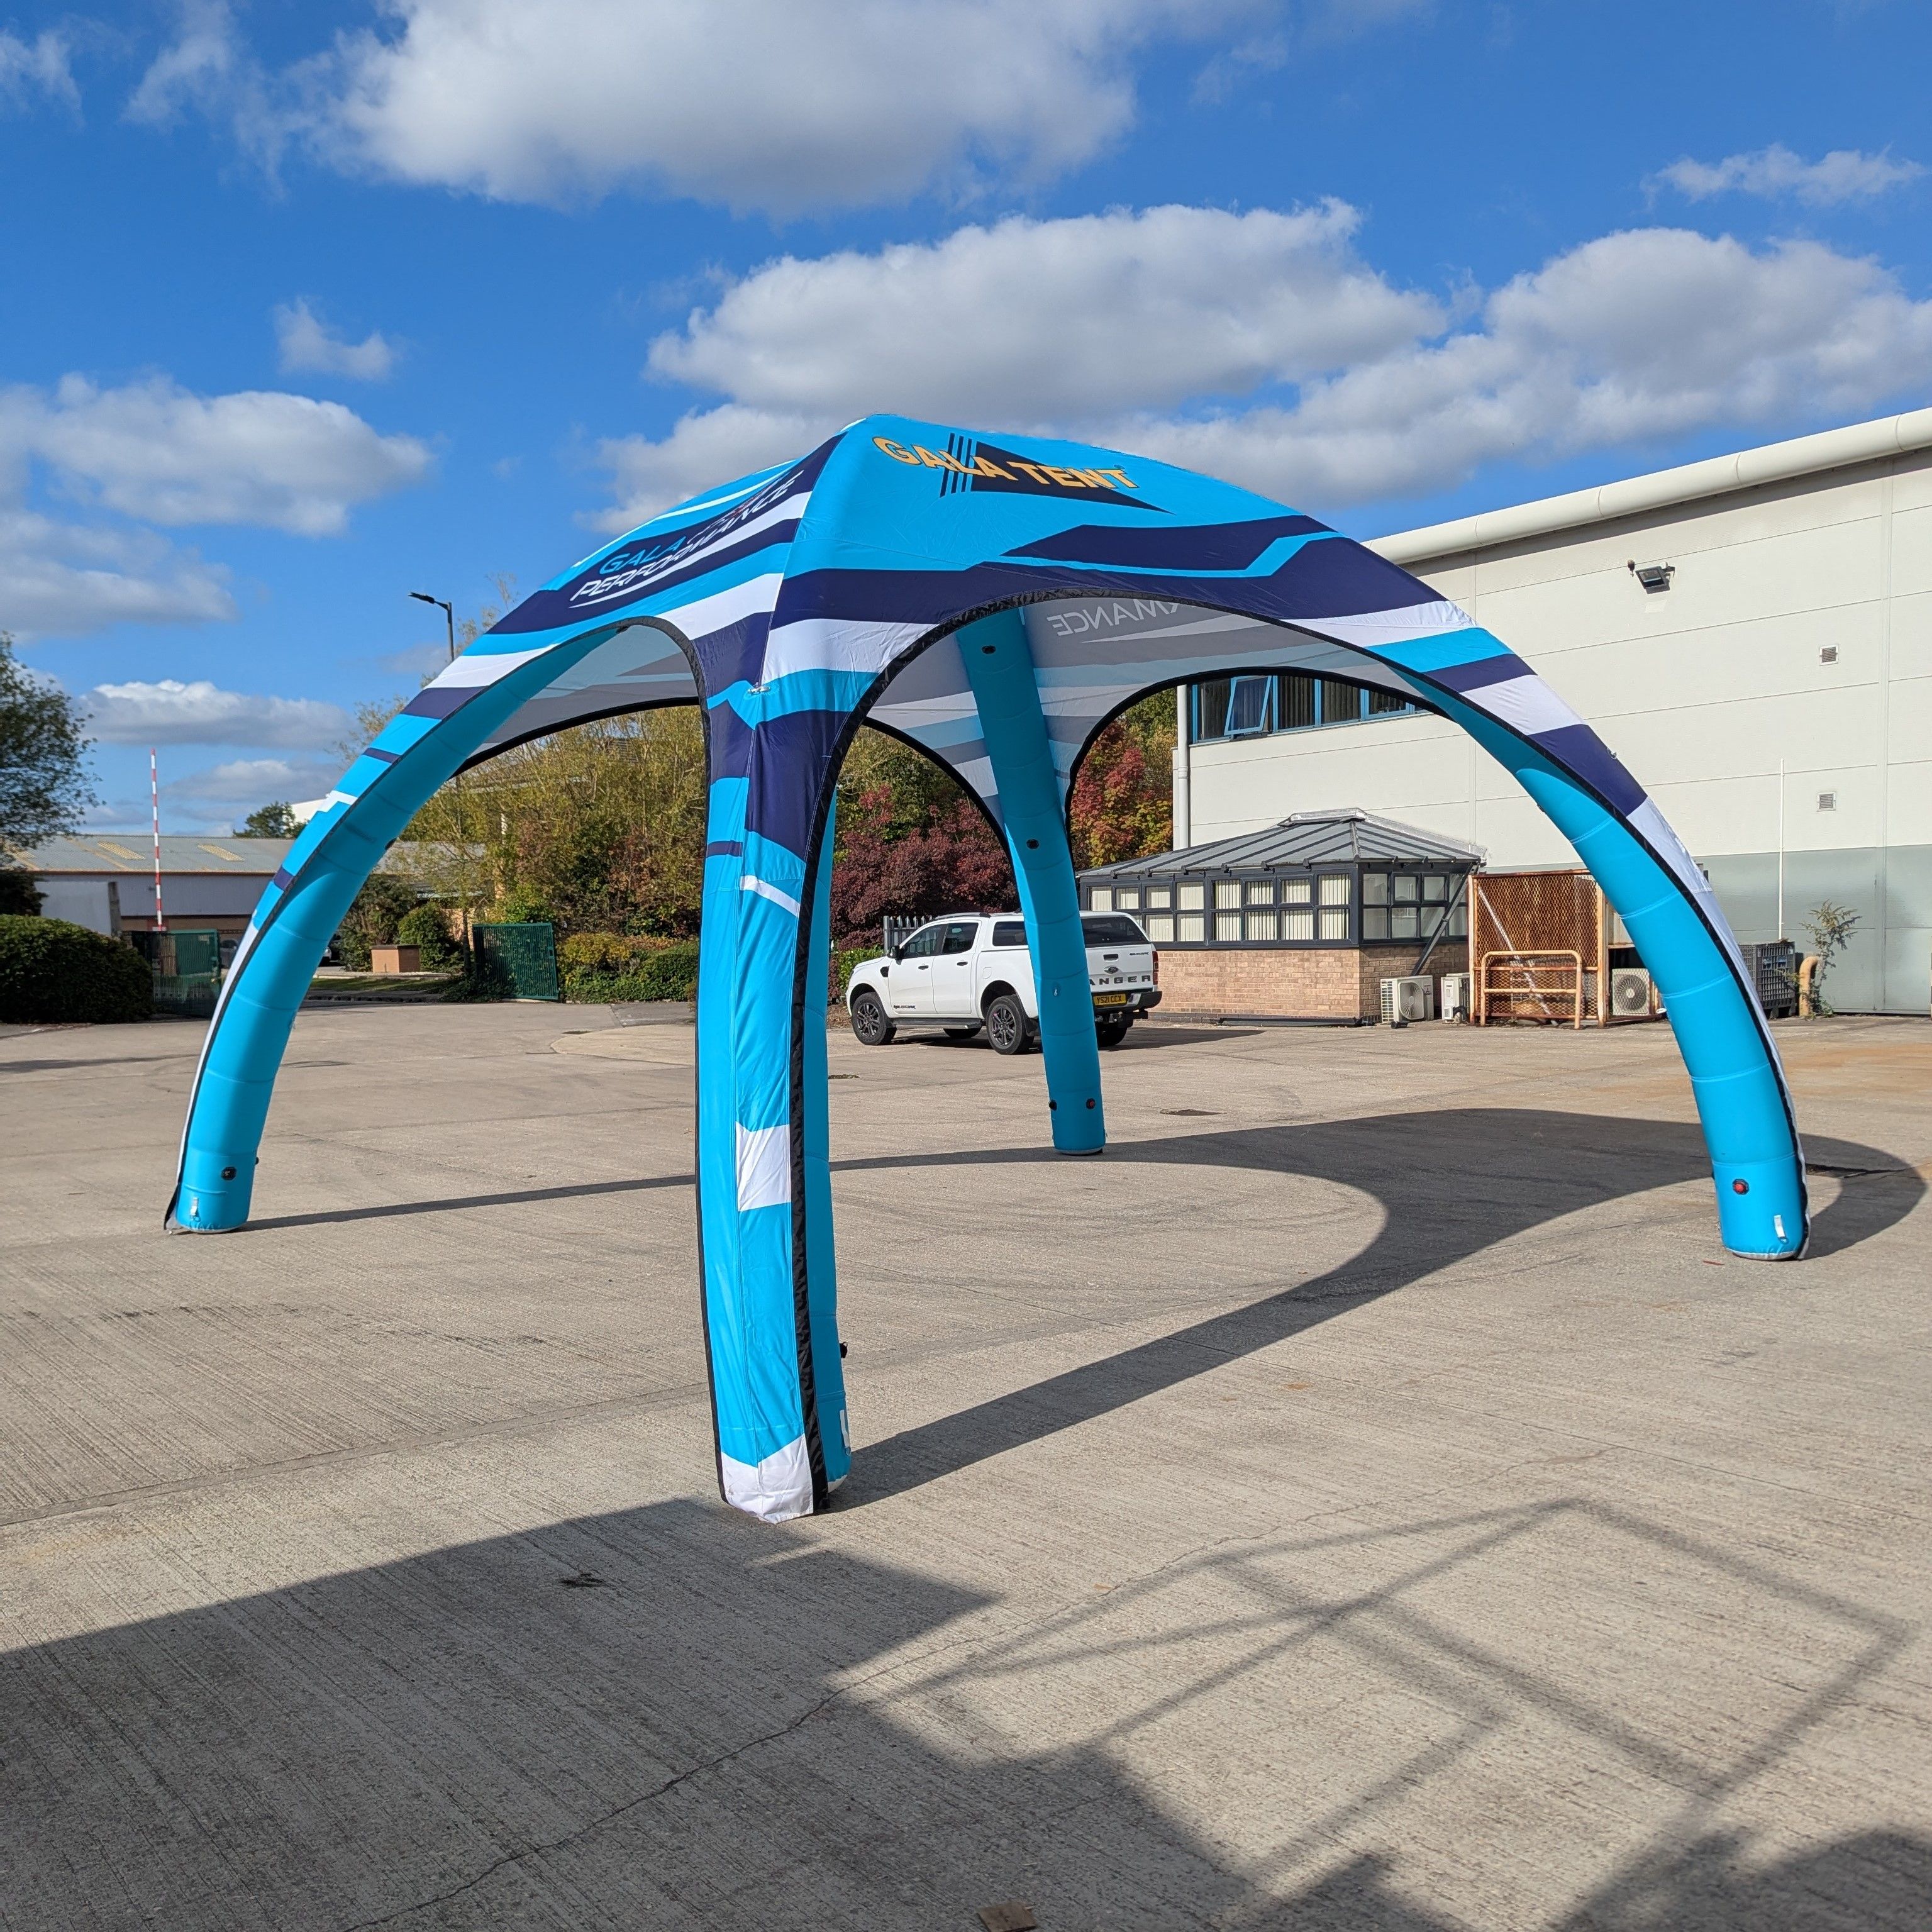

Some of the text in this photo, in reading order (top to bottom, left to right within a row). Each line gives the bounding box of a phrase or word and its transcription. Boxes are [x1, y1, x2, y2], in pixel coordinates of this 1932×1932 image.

[872, 436, 1019, 482] GALA
[599, 536, 687, 575] GALA
[1089, 975, 1151, 986] ANGER
[1096, 996, 1110, 1004] YS21
